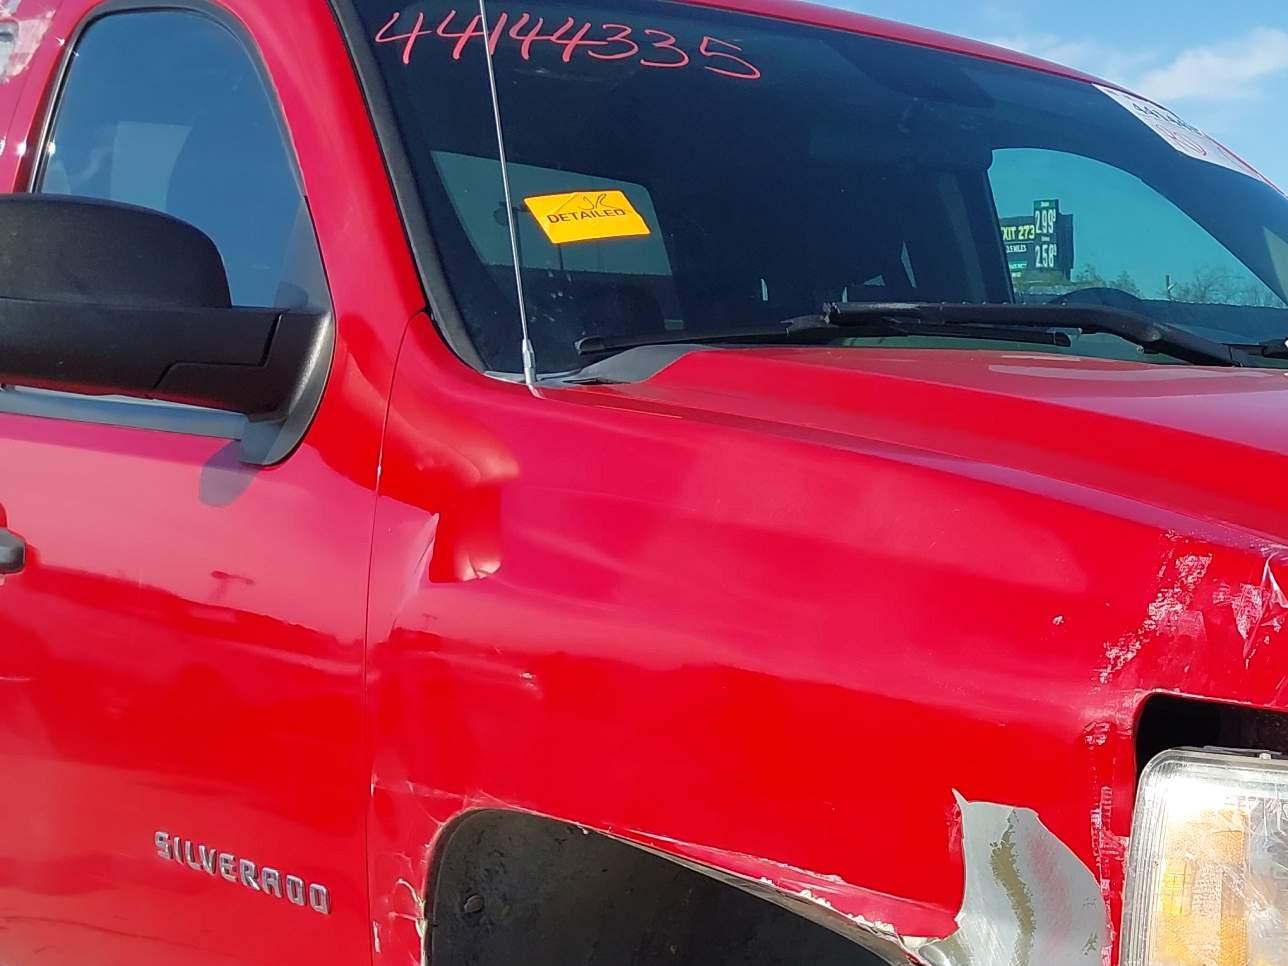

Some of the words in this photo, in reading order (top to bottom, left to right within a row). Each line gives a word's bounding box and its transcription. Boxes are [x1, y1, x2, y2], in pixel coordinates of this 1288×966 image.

[375, 9, 762, 80] 44144335
[546, 208, 627, 224] DETAILED
[1001, 226, 1016, 241] XIT
[1018, 225, 1035, 240] 273
[154, 831, 332, 915] SILVERADO
